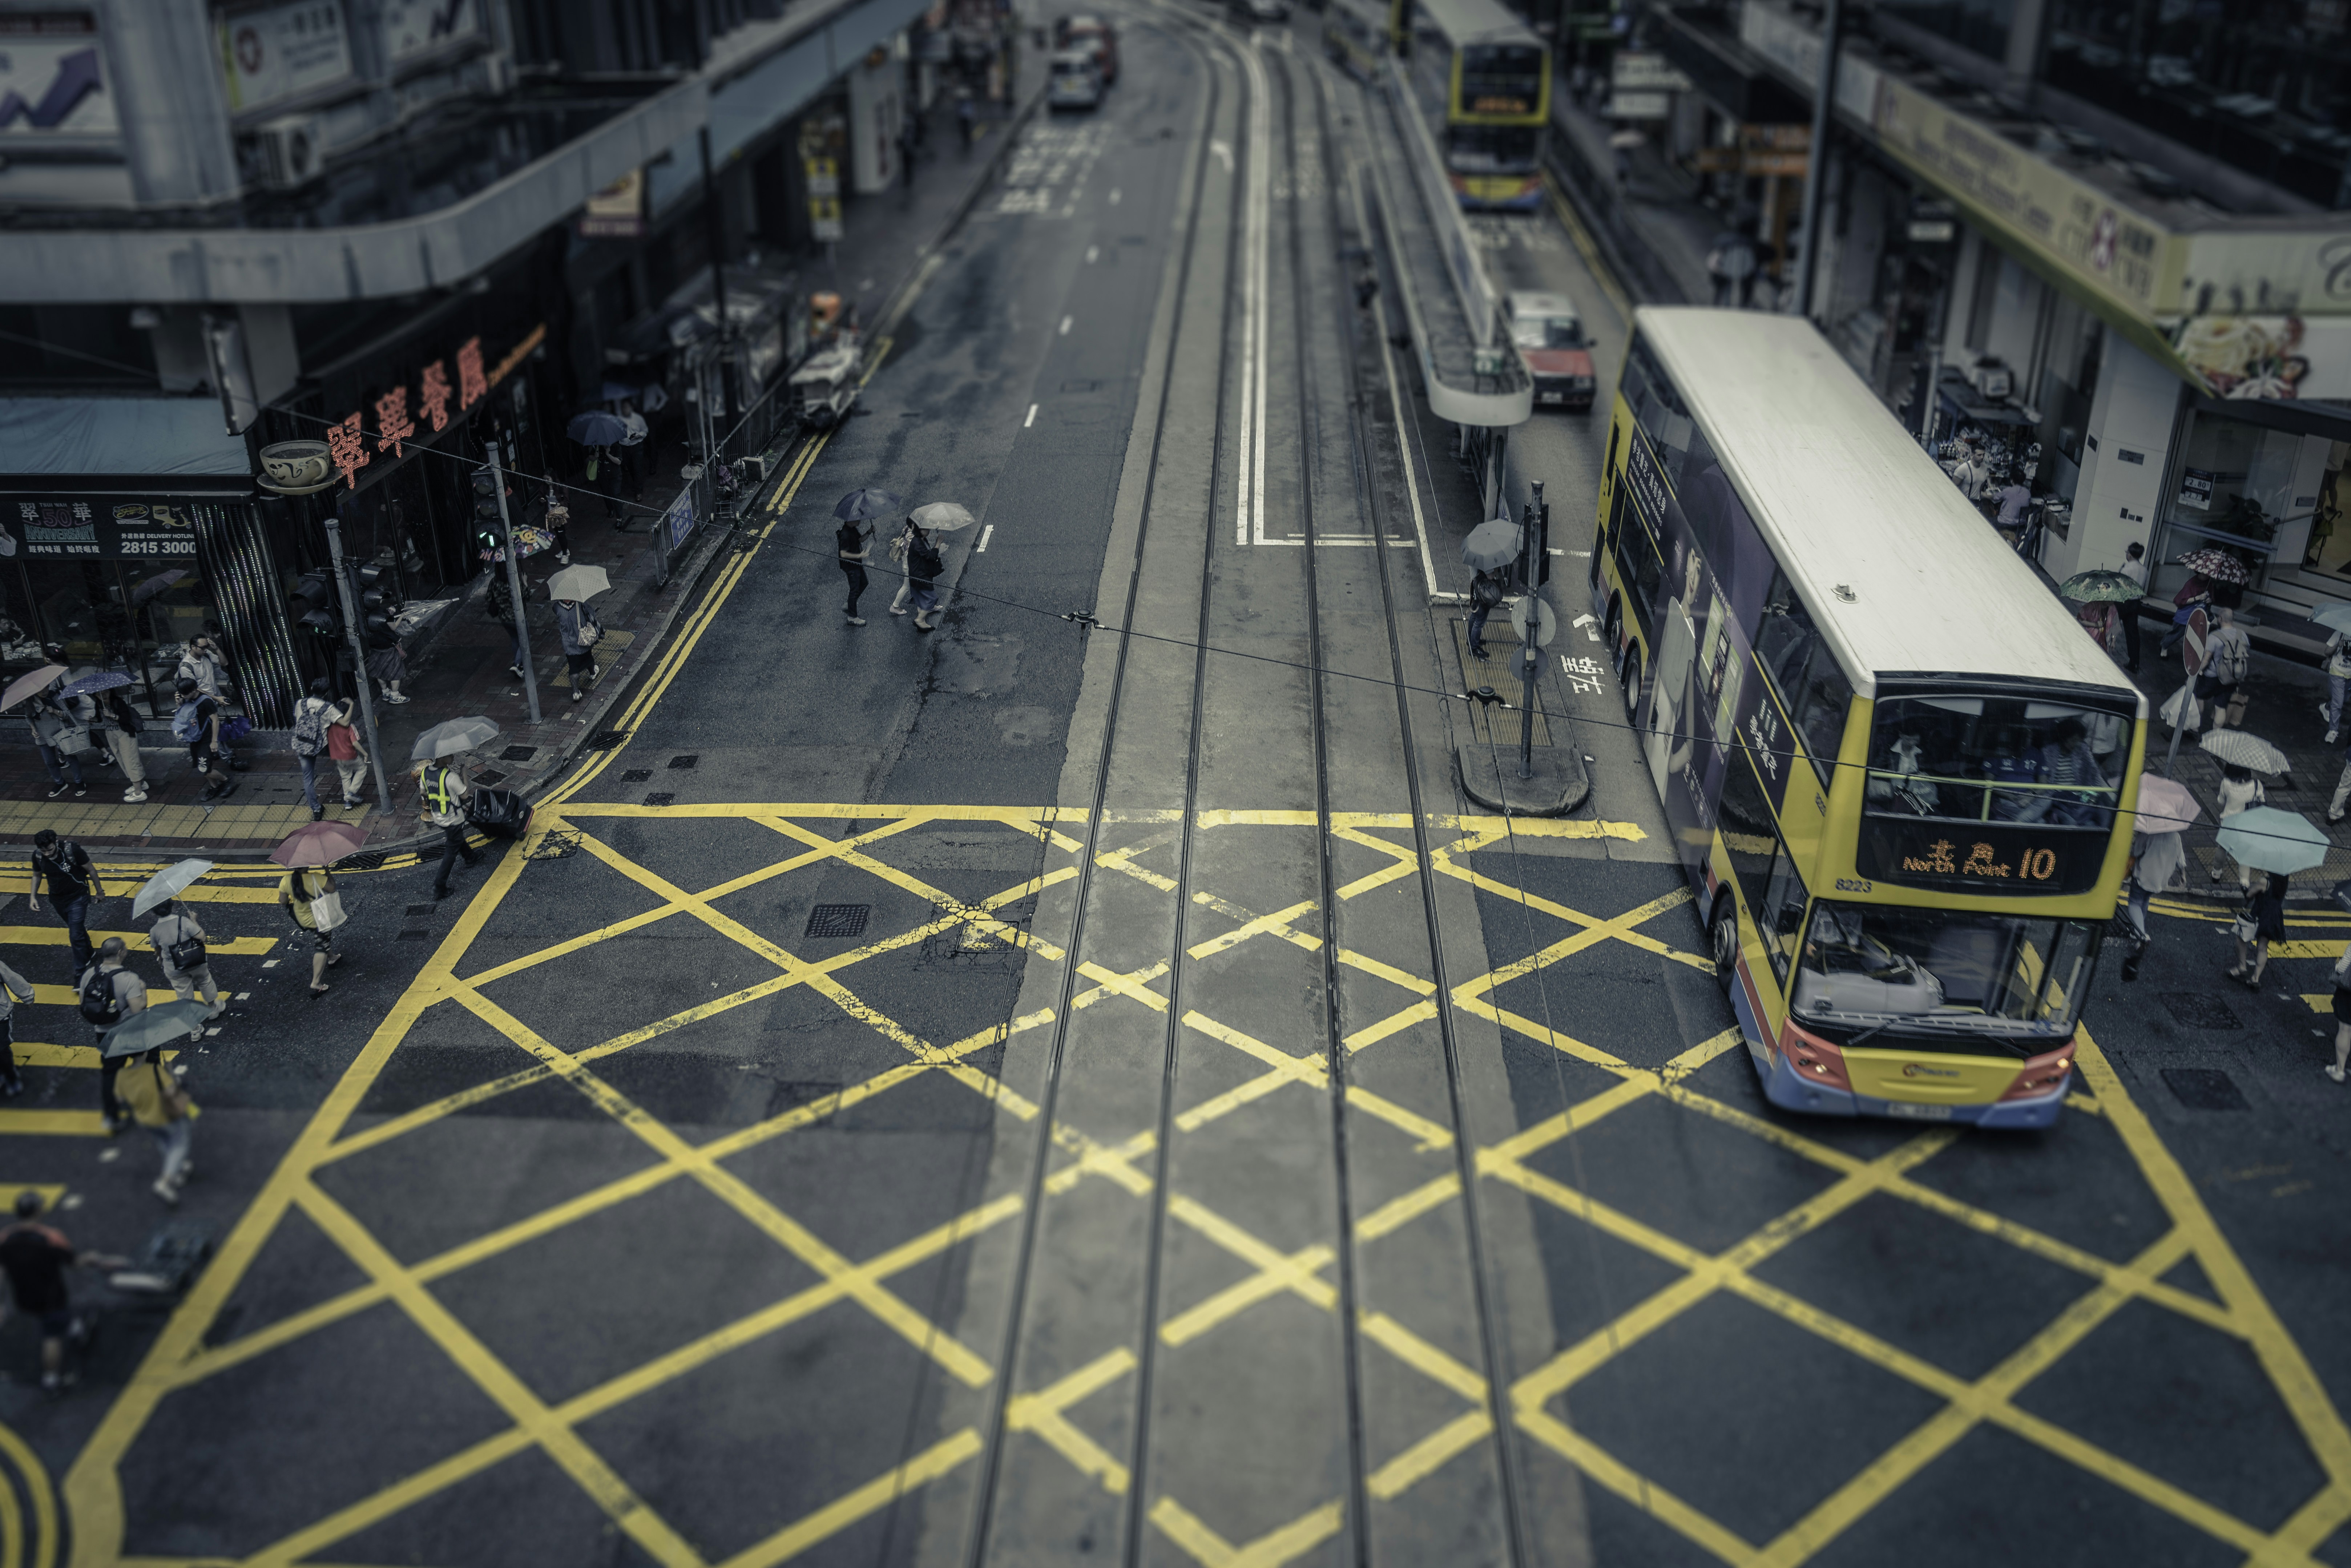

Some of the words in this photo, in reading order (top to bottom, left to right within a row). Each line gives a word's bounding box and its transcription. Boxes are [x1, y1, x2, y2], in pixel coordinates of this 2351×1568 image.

[19, 502, 39, 521] 翠
[73, 502, 91, 521] 華
[42, 508, 72, 527] 50
[24, 524, 95, 540] ANNIVERSARY
[121, 542, 158, 553] 2815
[162, 542, 197, 553] 3000
[1927, 838, 1995, 864] 北角
[1903, 856, 1956, 874] North
[1963, 860, 2012, 877] Point
[2019, 847, 2056, 880] 10
[1835, 878, 1873, 893] 8223
